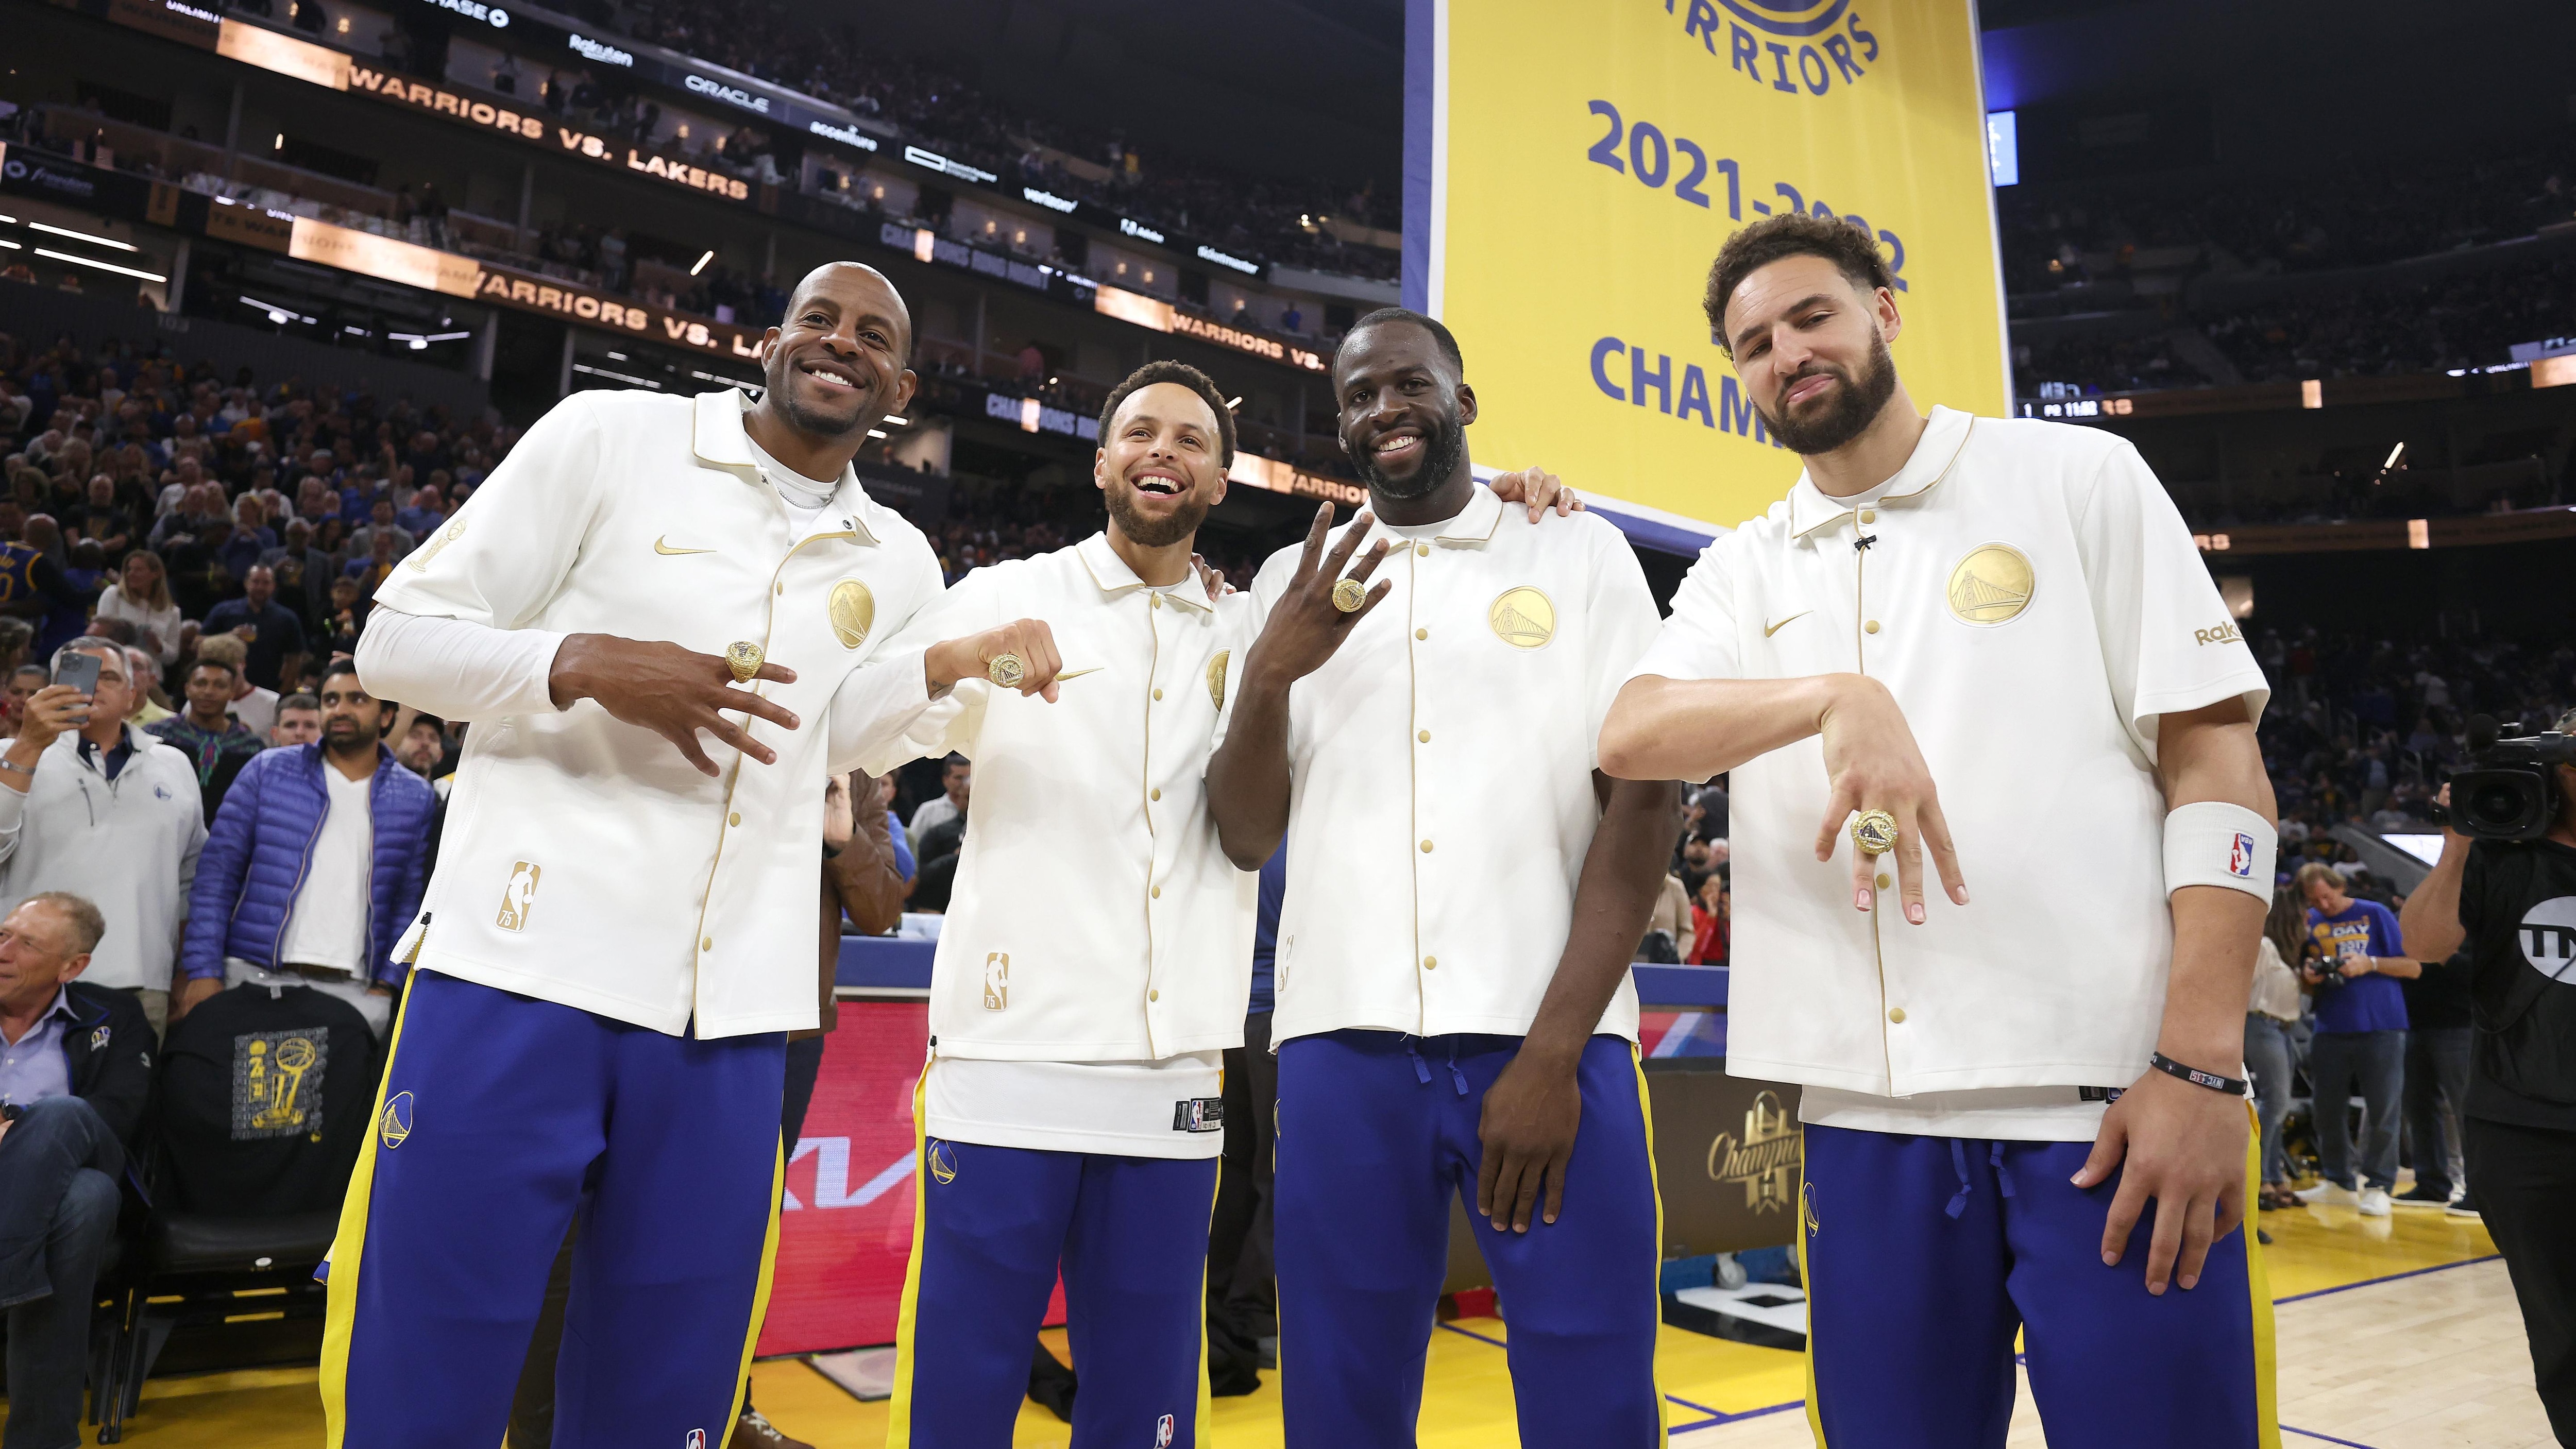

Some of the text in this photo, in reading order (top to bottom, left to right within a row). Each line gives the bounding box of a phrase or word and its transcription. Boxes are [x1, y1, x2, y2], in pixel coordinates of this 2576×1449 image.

[1665, 0, 1878, 96] RRIORS
[684, 74, 770, 113] ORACLE
[350, 64, 749, 201] WARRIORS VS. LAKERS
[662, 316, 718, 348] VS.
[1171, 312, 1325, 371] WARRIORS VS.
[1590, 336, 1783, 449] CHAM
[499, 909, 514, 927] 75
[985, 994, 995, 1009] 75
